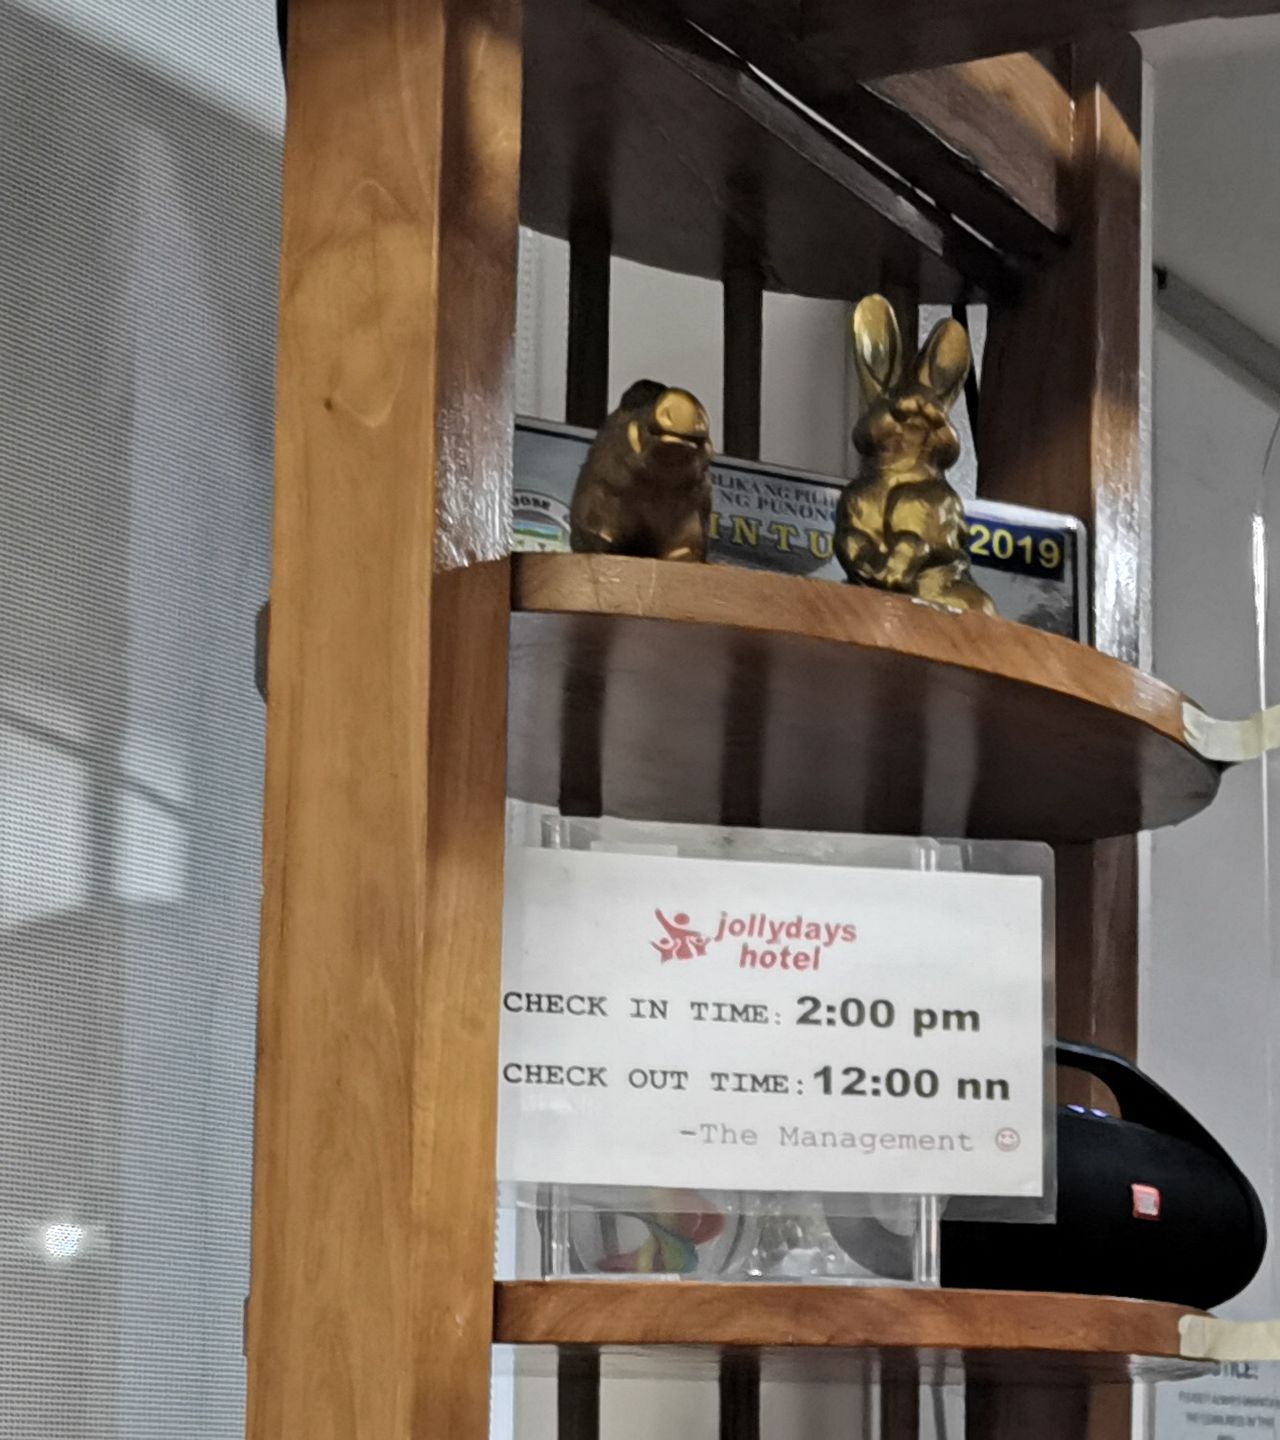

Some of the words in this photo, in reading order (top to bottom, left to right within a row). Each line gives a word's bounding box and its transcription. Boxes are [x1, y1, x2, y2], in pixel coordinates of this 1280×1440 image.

[969, 523, 1061, 570] 2019
[714, 910, 857, 948] jollydays
[740, 944, 821, 971] hotel
[503, 990, 608, 1018] CHECK
[629, 998, 668, 1020] IN
[691, 1001, 781, 1026] TIME:
[796, 996, 896, 1029] 2:00
[913, 1006, 981, 1038] pm
[503, 1062, 608, 1090] CHECK
[628, 1070, 689, 1092] OUT
[956, 1075, 1011, 1102] nn
[679, 1123, 759, 1147] -The
[780, 1124, 975, 1155] Management
